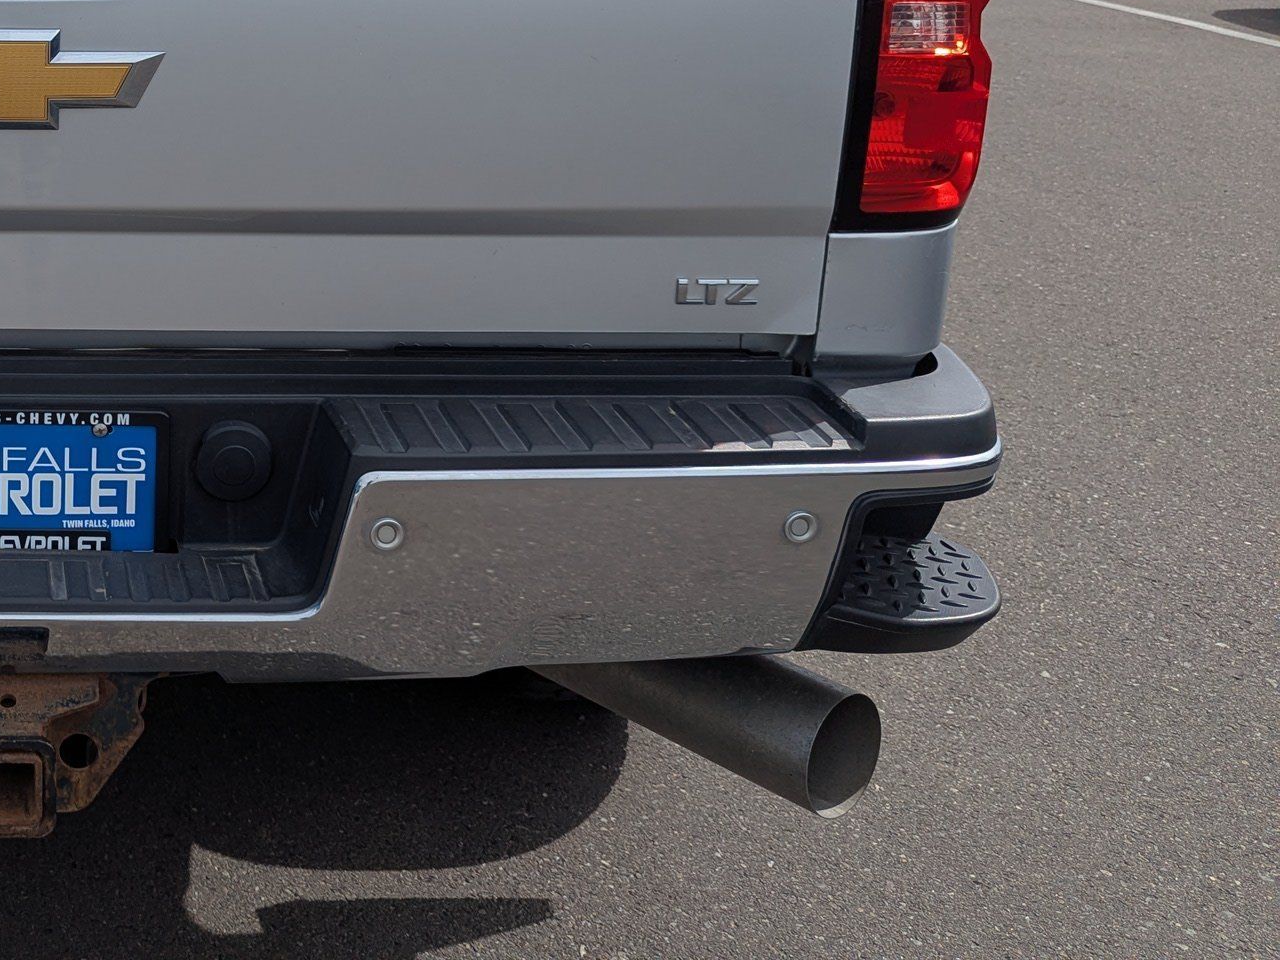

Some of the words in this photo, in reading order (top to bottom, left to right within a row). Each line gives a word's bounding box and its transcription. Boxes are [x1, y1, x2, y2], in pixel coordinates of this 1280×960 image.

[675, 278, 759, 305] LTZ
[62, 520, 83, 528] TWIN
[84, 520, 109, 529] FALLS,
[111, 520, 135, 528] IDAHO
